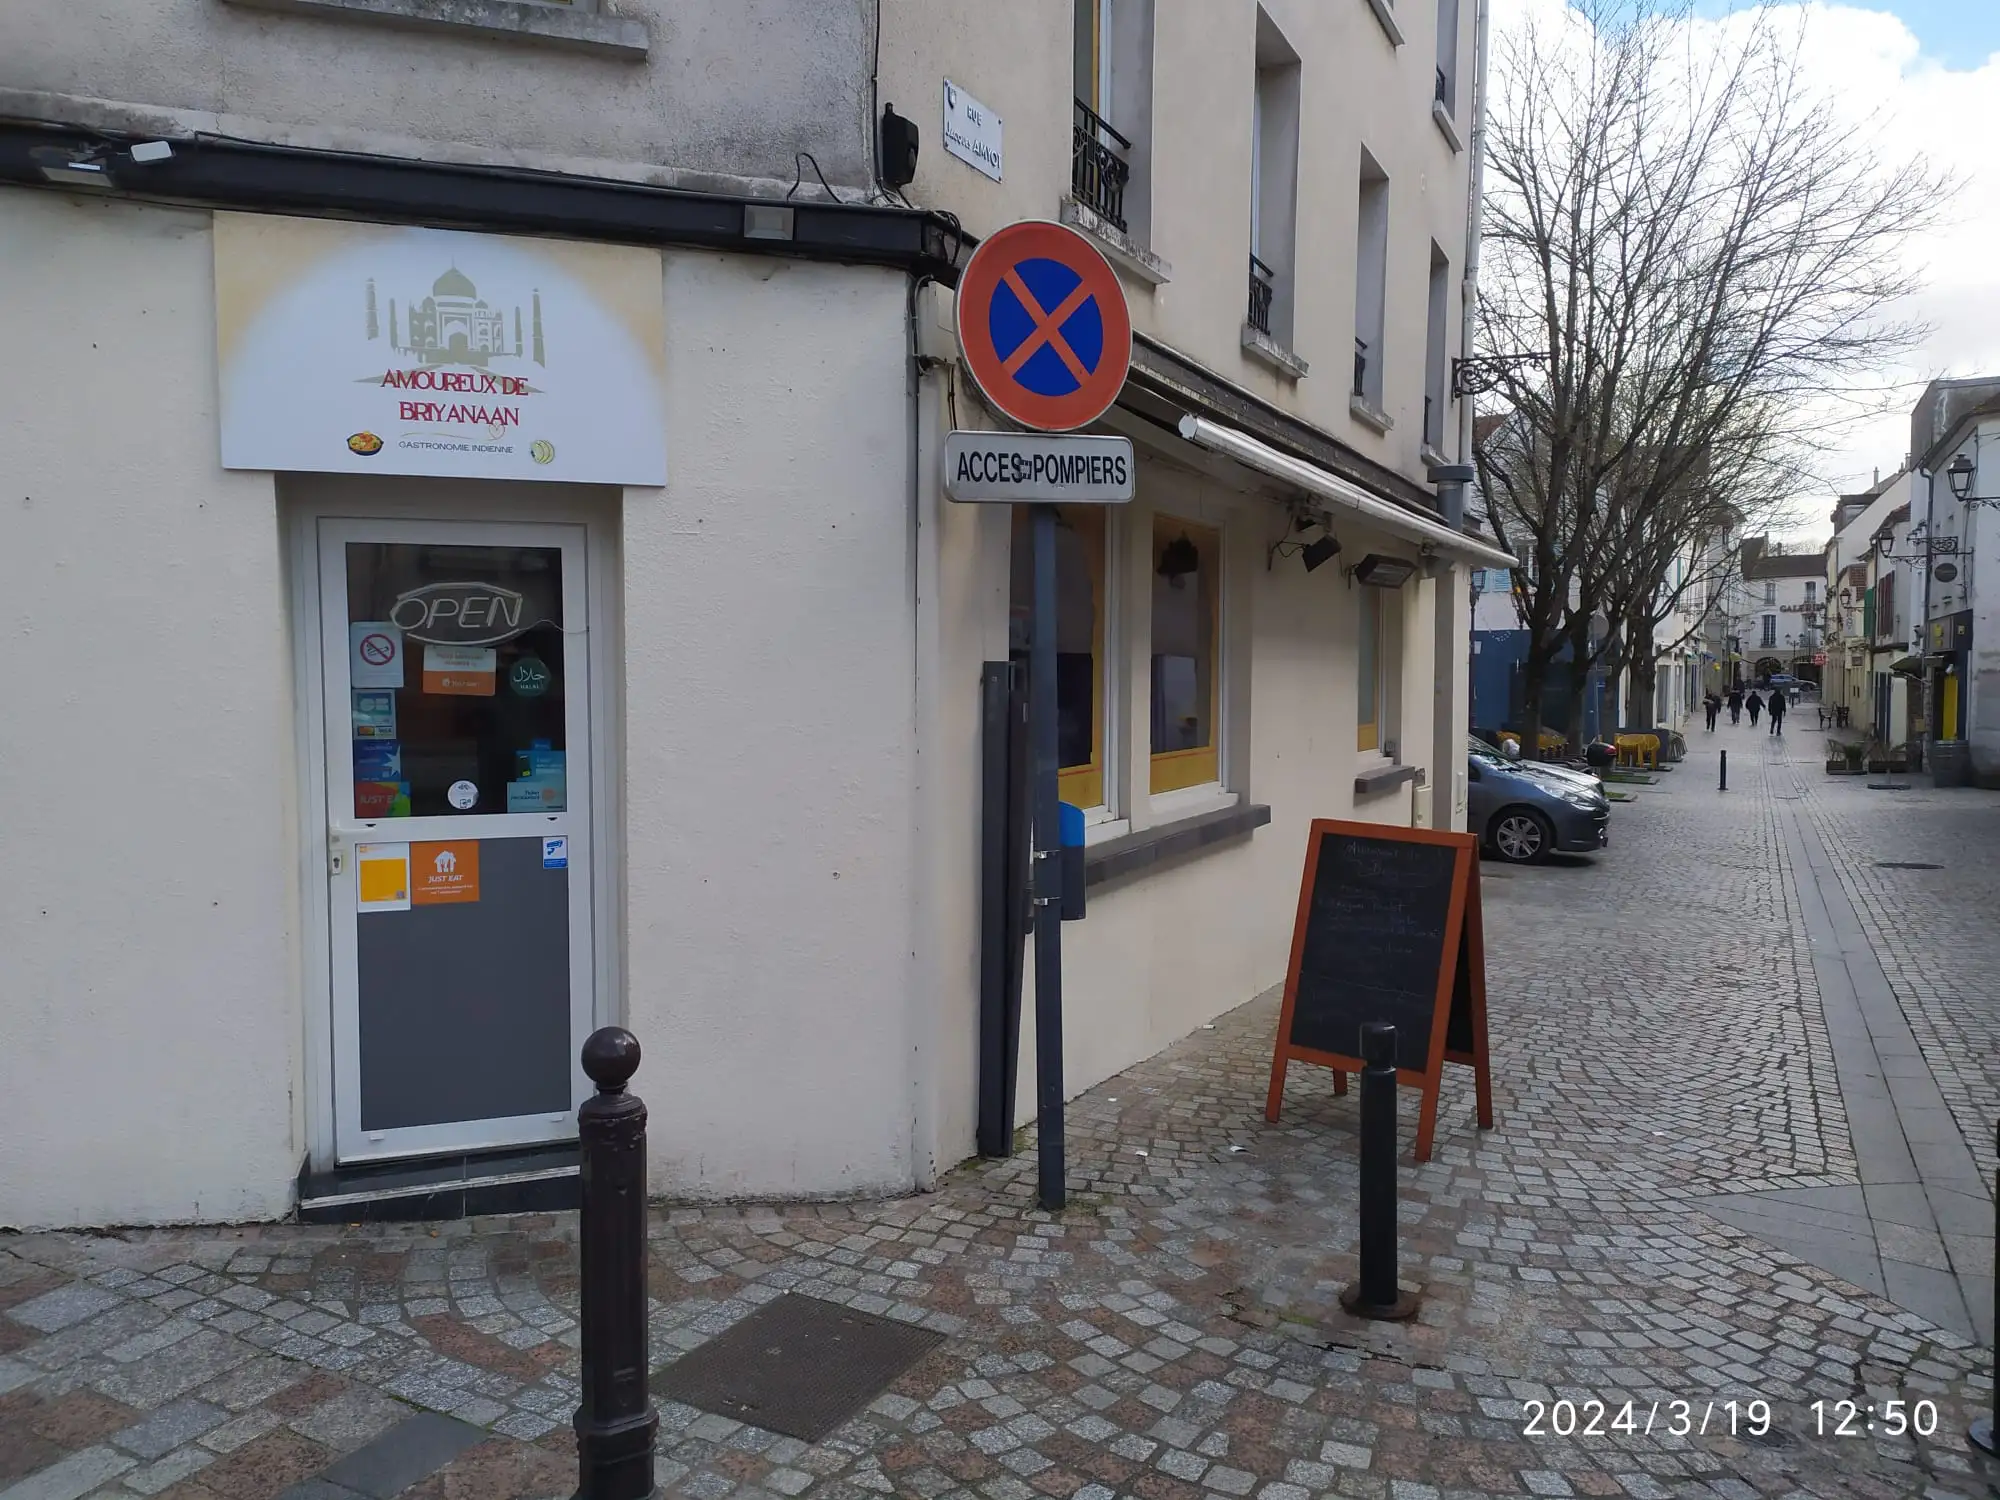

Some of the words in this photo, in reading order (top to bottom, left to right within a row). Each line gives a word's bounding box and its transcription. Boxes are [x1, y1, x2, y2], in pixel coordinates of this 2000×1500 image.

[966, 104, 982, 127] RUE
[380, 368, 497, 395] AMOUREUX
[502, 376, 529, 396] DE
[399, 401, 520, 426] BRIYANAAN
[399, 441, 470, 452] GASTRONOMIE
[471, 444, 513, 454] INDIENNE
[957, 451, 1024, 484] ACCES
[1032, 453, 1128, 486] POMPIERS
[391, 596, 523, 630] OPEN
[513, 666, 545, 683] حلال
[428, 875, 447, 884] JUST
[448, 874, 464, 882] EAT
